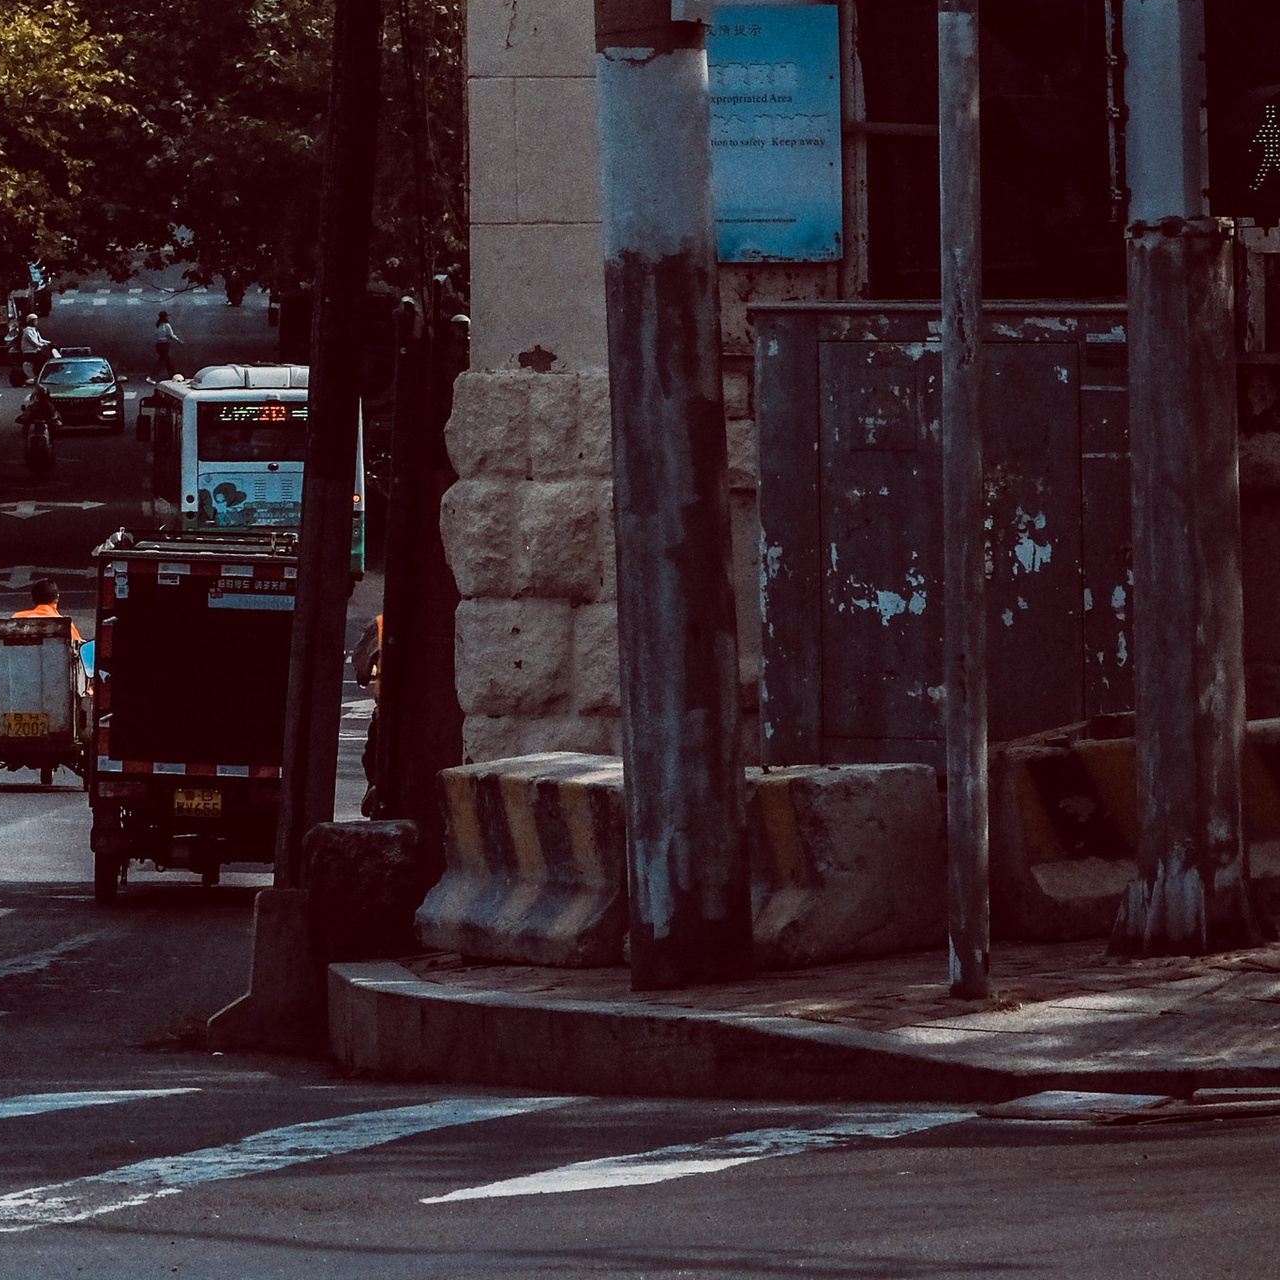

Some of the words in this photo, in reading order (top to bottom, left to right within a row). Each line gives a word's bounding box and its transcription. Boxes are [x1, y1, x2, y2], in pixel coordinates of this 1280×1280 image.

[710, 93, 768, 106] xpropriated
[770, 93, 793, 103] Area
[729, 138, 739, 147] to
[740, 137, 766, 148] safety
[771, 137, 797, 148] Keep
[799, 138, 826, 148] away
